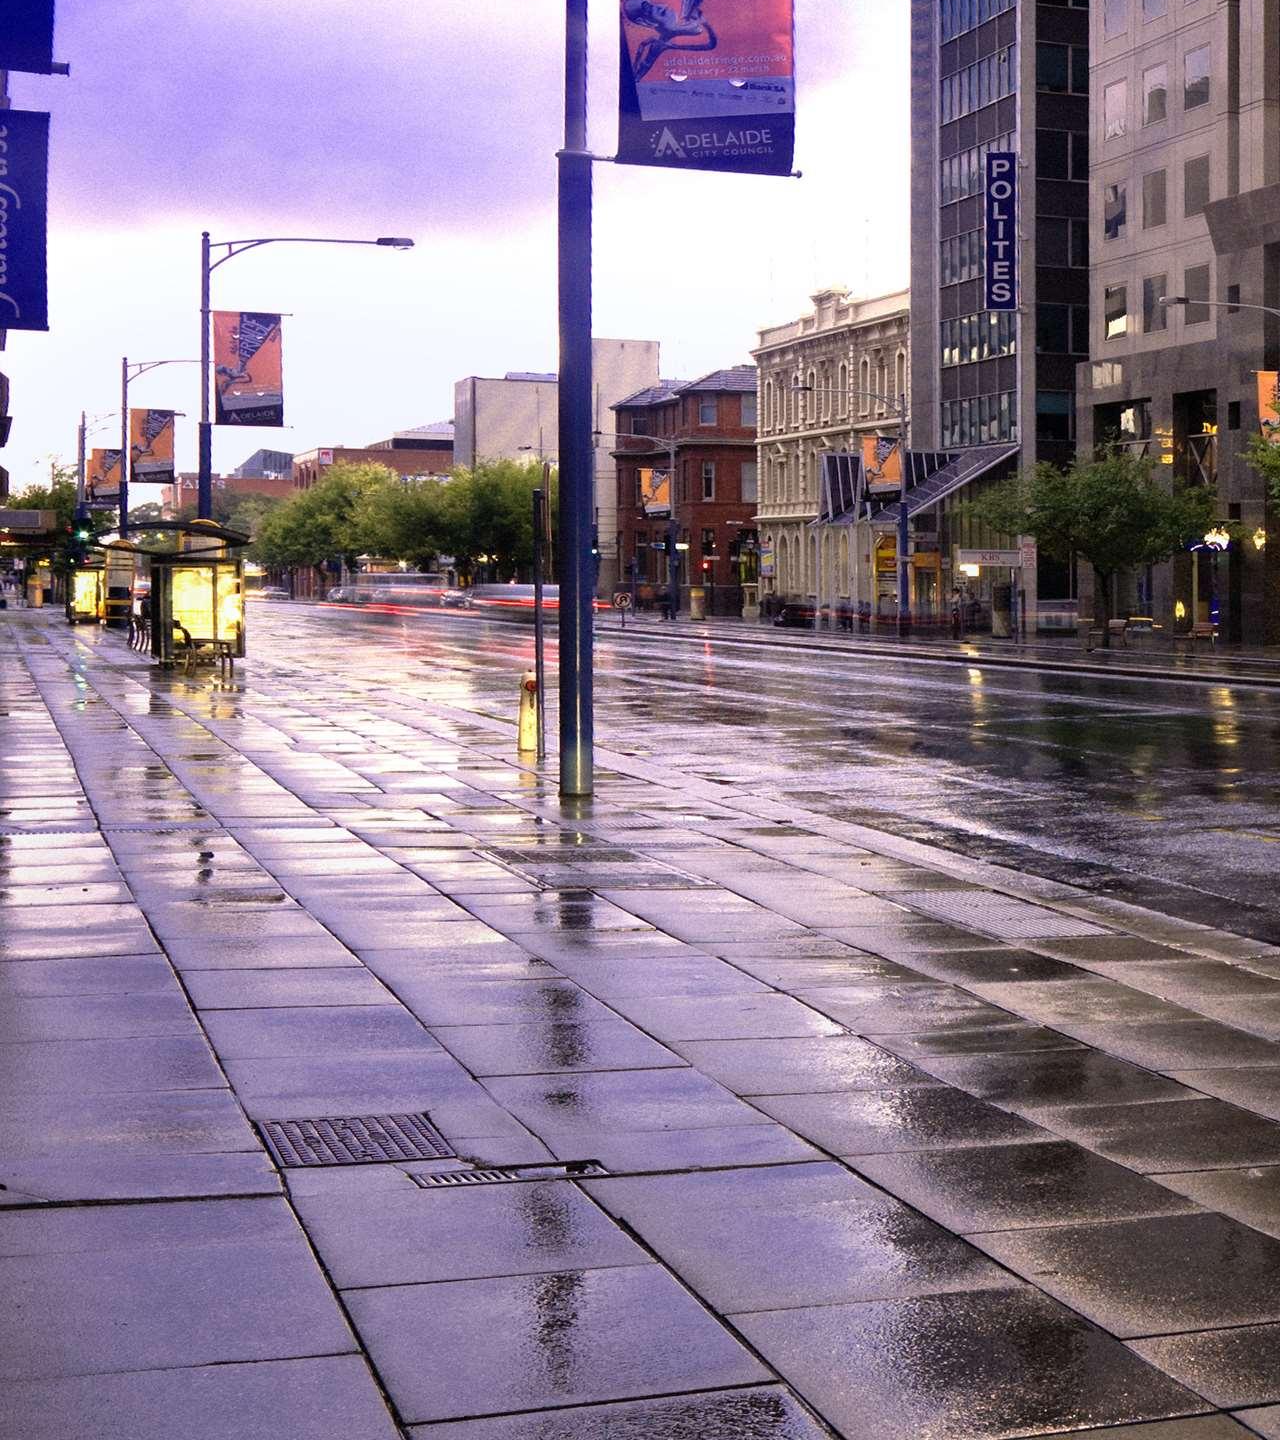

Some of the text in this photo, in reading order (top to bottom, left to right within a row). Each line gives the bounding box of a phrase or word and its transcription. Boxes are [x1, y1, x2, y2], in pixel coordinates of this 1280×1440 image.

[691, 146, 775, 159] CITY COUNCIL
[990, 160, 1012, 302] POLITES
